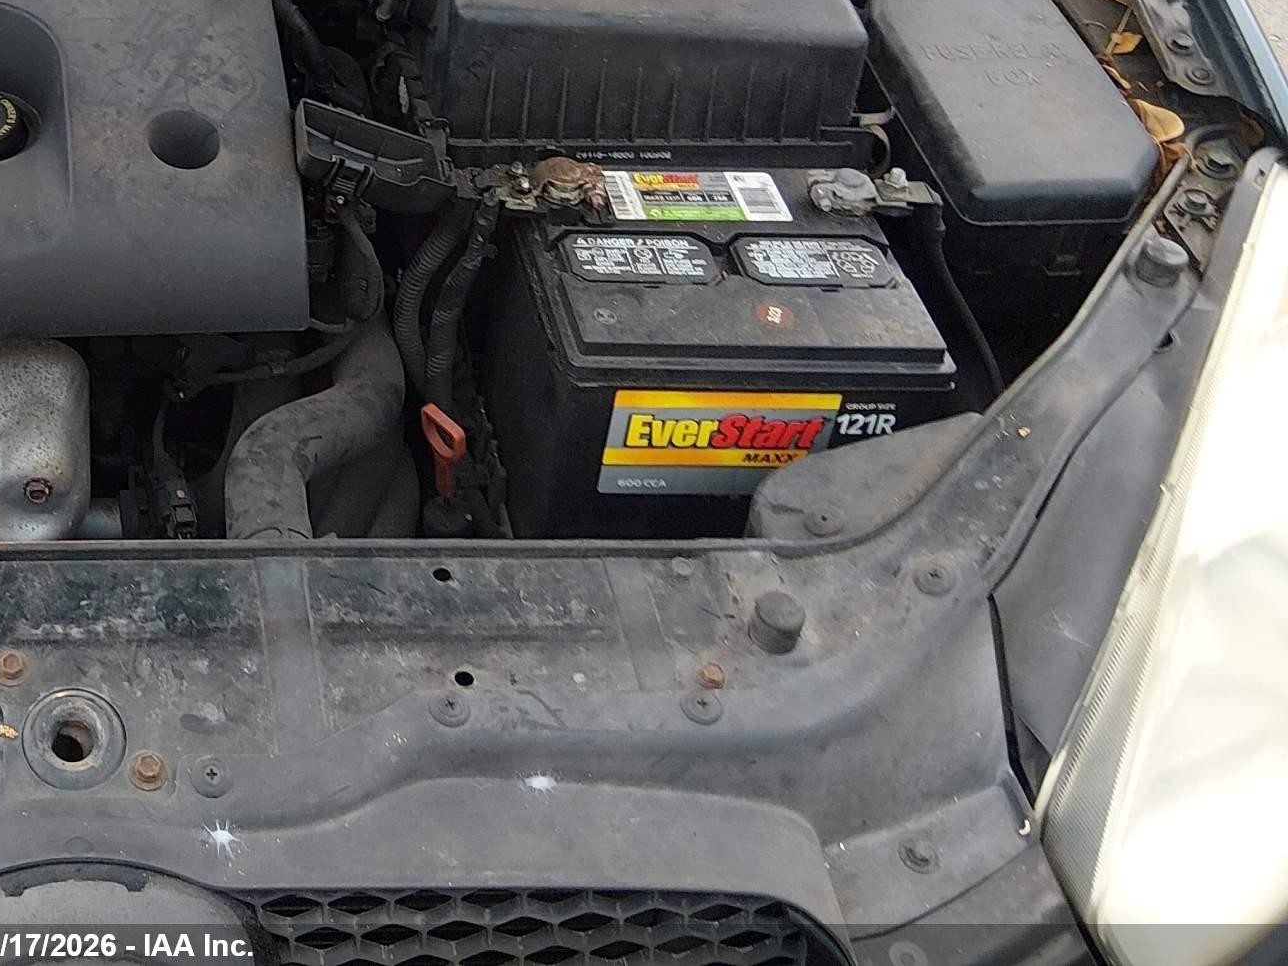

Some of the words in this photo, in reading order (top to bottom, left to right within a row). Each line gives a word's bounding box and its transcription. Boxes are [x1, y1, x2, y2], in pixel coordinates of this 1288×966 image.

[632, 172, 699, 184] EverStart
[587, 237, 635, 248] DANGER
[645, 238, 689, 248] POISON
[845, 402, 876, 411] GROUP
[877, 402, 897, 411] SIZE
[836, 413, 897, 435] 121R
[624, 412, 825, 449] EverStart
[742, 452, 799, 464] MAXX
[617, 477, 642, 488] 600
[643, 477, 667, 488] CCA
